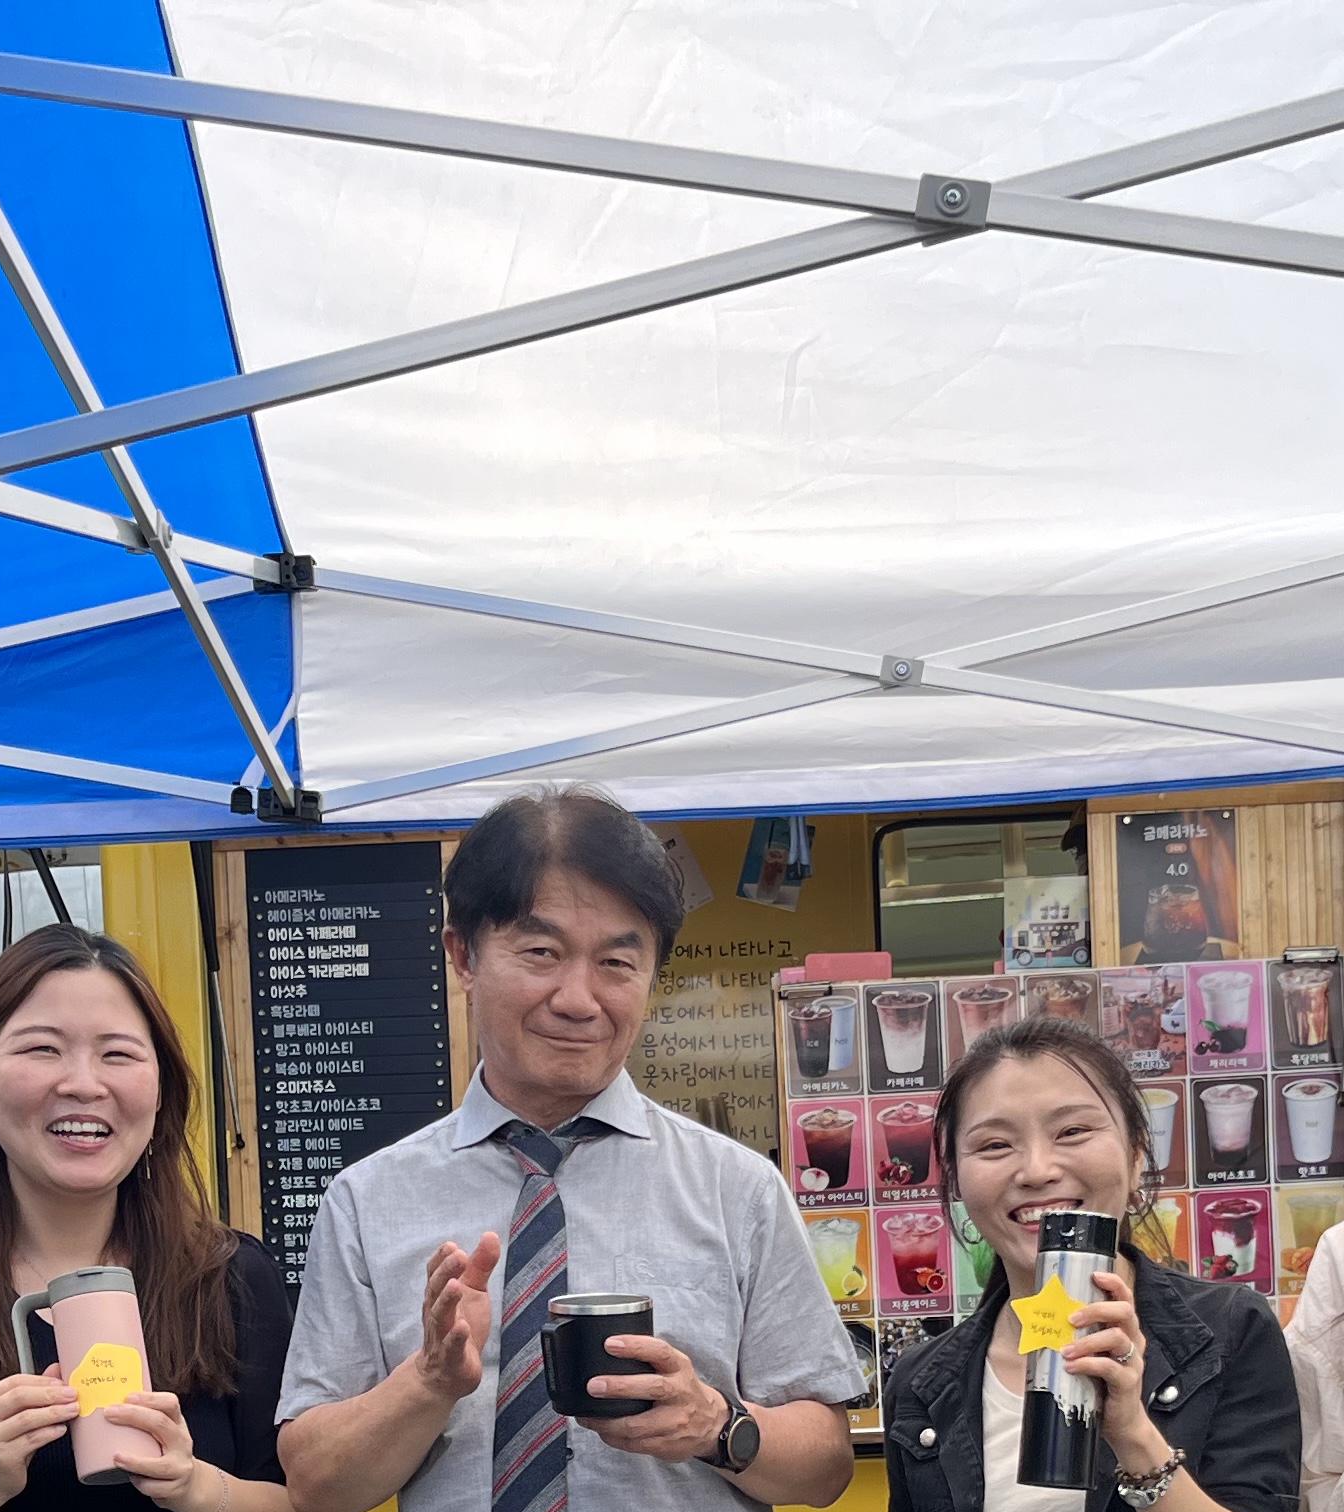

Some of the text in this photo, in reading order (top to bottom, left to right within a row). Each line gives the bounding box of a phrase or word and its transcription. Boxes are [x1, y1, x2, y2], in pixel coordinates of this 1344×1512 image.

[1143, 824, 1208, 841] 금메리카노
[1166, 863, 1188, 877] 4.0
[264, 889, 326, 904] 아메리카노
[267, 906, 381, 922] 헤이즐넛 아메리카노
[268, 925, 356, 942] 아이스 카페라떼
[269, 943, 369, 961] 아이스 바닐라라떼
[667, 940, 793, 961] 에서 나타나고
[269, 963, 369, 980] 아이스 카라멜라떼
[658, 970, 713, 996] 형에서
[270, 1004, 320, 1019] 흑당라떼
[273, 1021, 374, 1038] 블루베리 아이스티
[275, 1041, 353, 1057] 망고 아이스티
[641, 1031, 715, 1059] 음성에서
[275, 1060, 364, 1076] 복숭아 아이스티
[642, 1062, 736, 1089] 옷차림에서
[276, 1079, 337, 1095] 오미자쥬스
[662, 1091, 774, 1117] 머리락에서
[327, 1117, 364, 1131] 에이드
[277, 1137, 342, 1152] 레몬 에이드
[278, 1156, 344, 1171] 자몽 에이드
[279, 1175, 317, 1190] 청포도
[281, 1194, 323, 1208] 자몽허
[827, 1191, 864, 1204] 아이스티
[283, 1233, 310, 1247] 딸기
